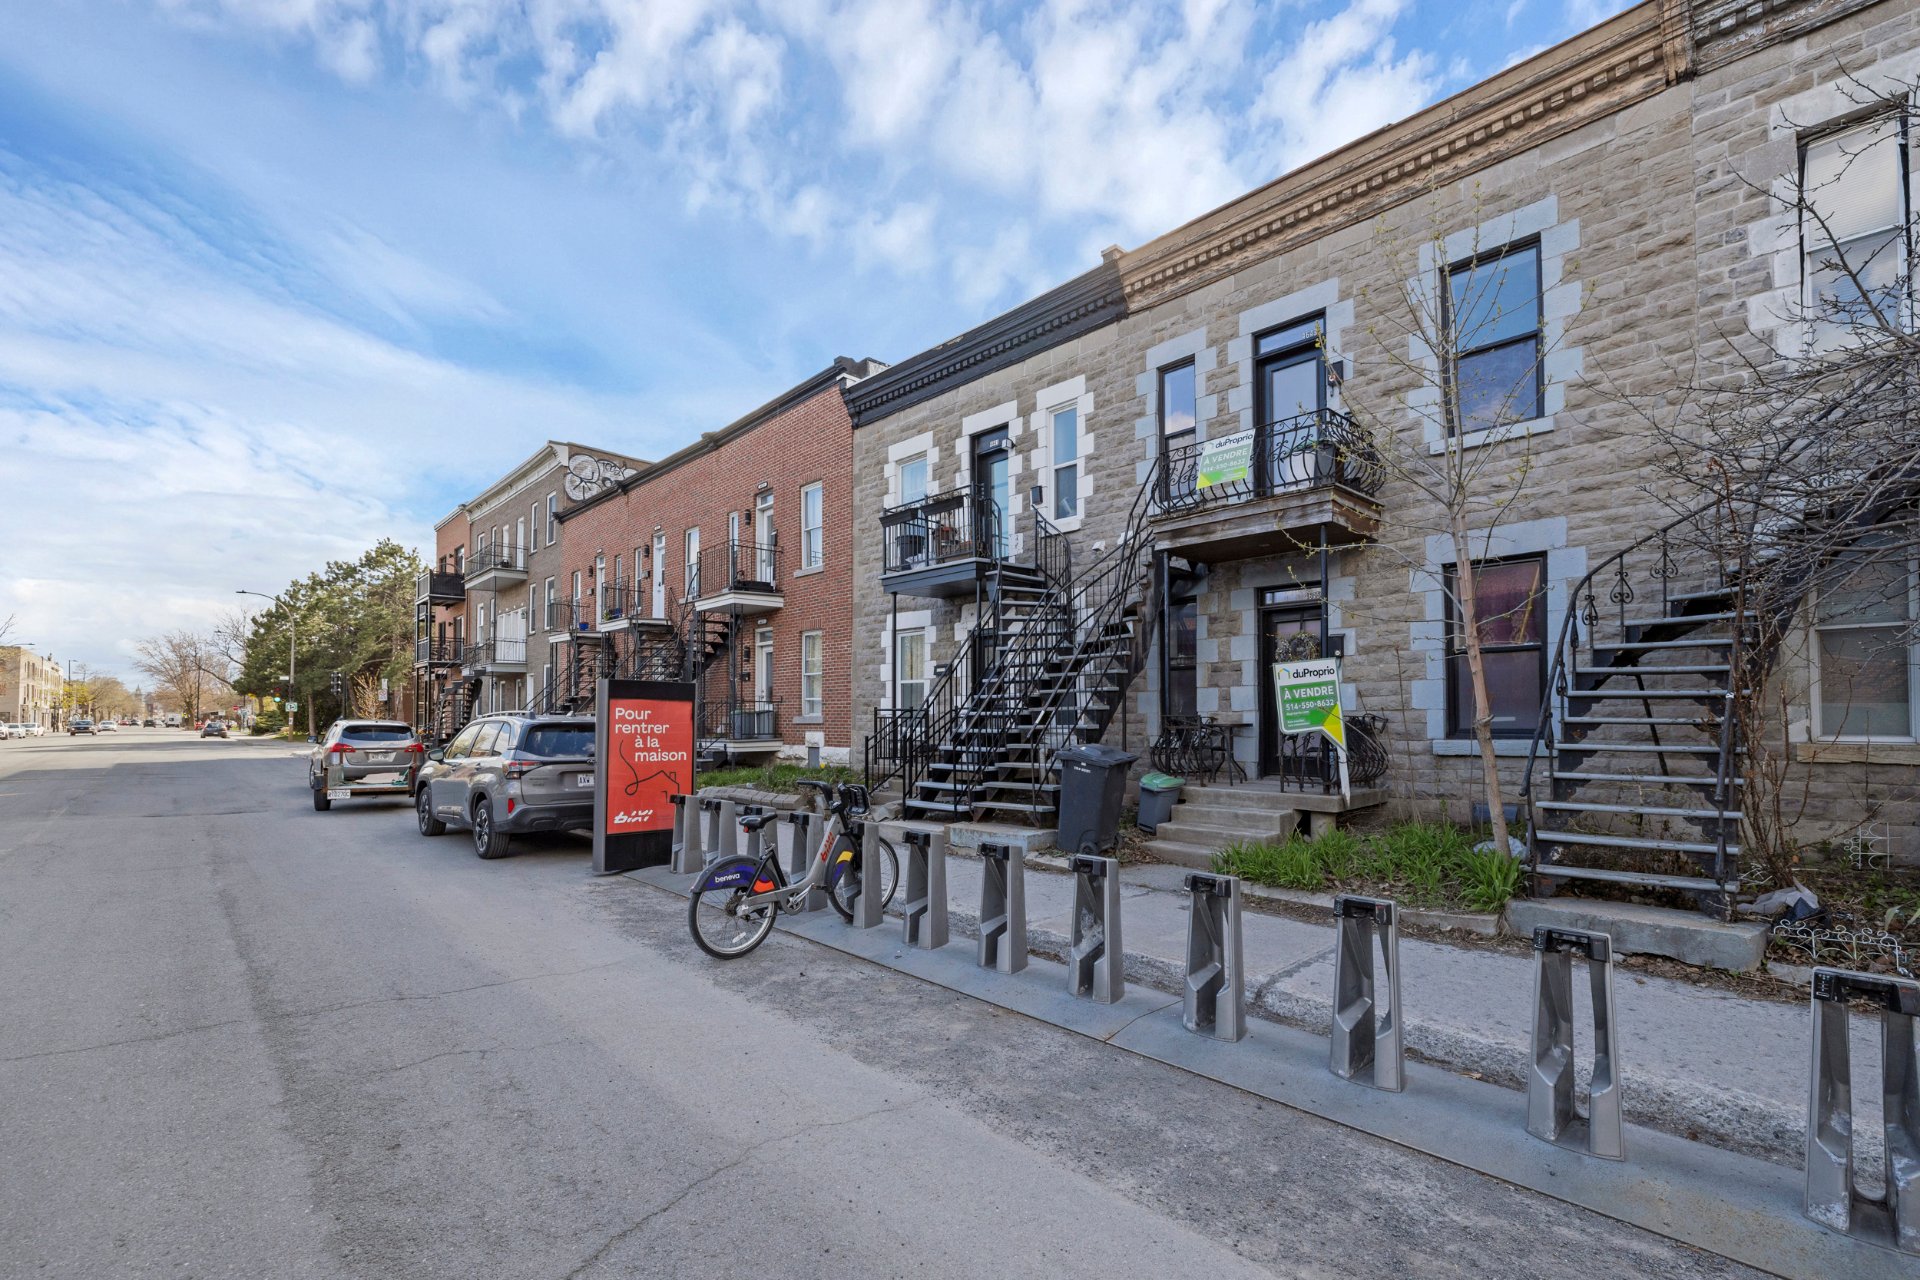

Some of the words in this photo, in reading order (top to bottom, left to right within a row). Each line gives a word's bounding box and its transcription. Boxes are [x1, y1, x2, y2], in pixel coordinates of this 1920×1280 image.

[1215, 433, 1254, 449] duProprio
[1212, 448, 1248, 463] VENDRE
[1292, 666, 1335, 679] duProprio
[1284, 688, 1291, 700] À
[1293, 685, 1334, 698] VENDRE
[615, 707, 652, 720] Pour
[615, 722, 670, 734] rentrer
[635, 736, 644, 748] à
[647, 737, 660, 748] la
[635, 749, 687, 762] maison
[714, 873, 741, 883] beneva
